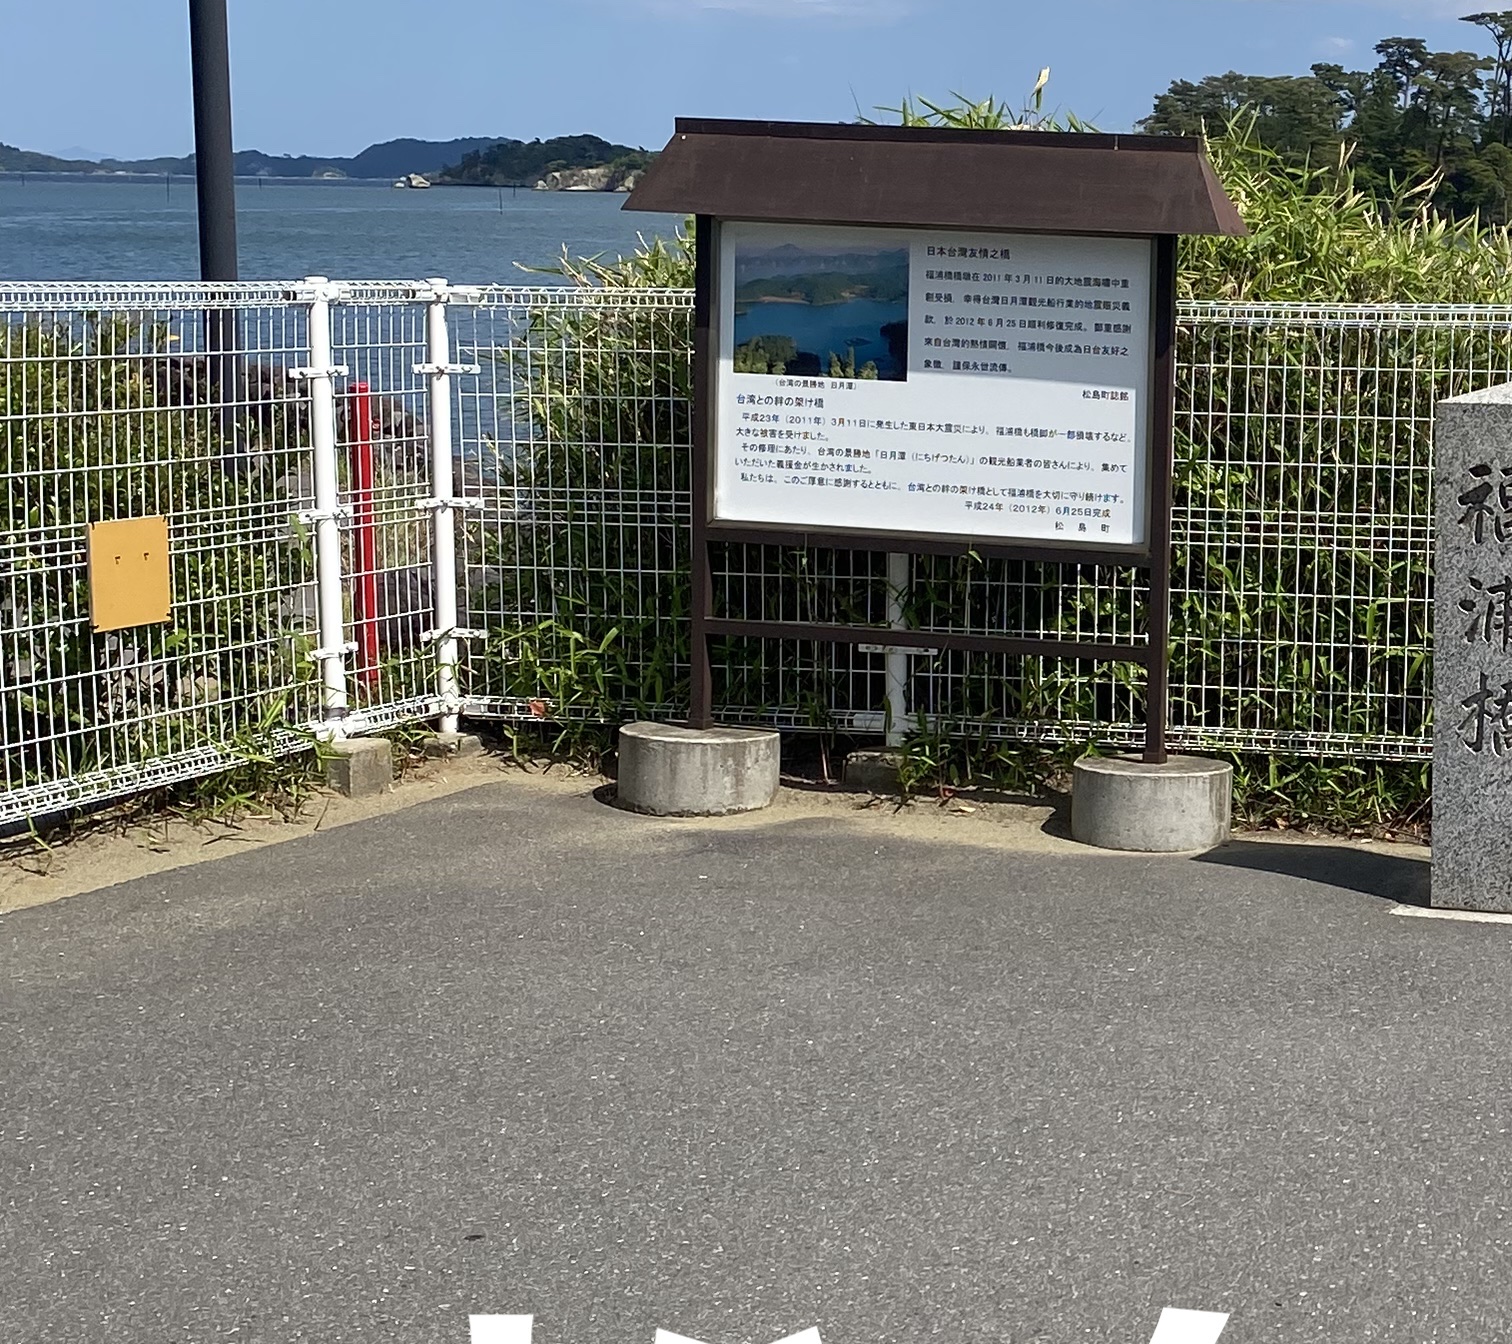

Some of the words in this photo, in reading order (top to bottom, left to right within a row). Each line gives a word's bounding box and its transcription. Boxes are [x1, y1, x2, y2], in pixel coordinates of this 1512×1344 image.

[736, 394, 825, 409] 台湾との絆の架け橋
